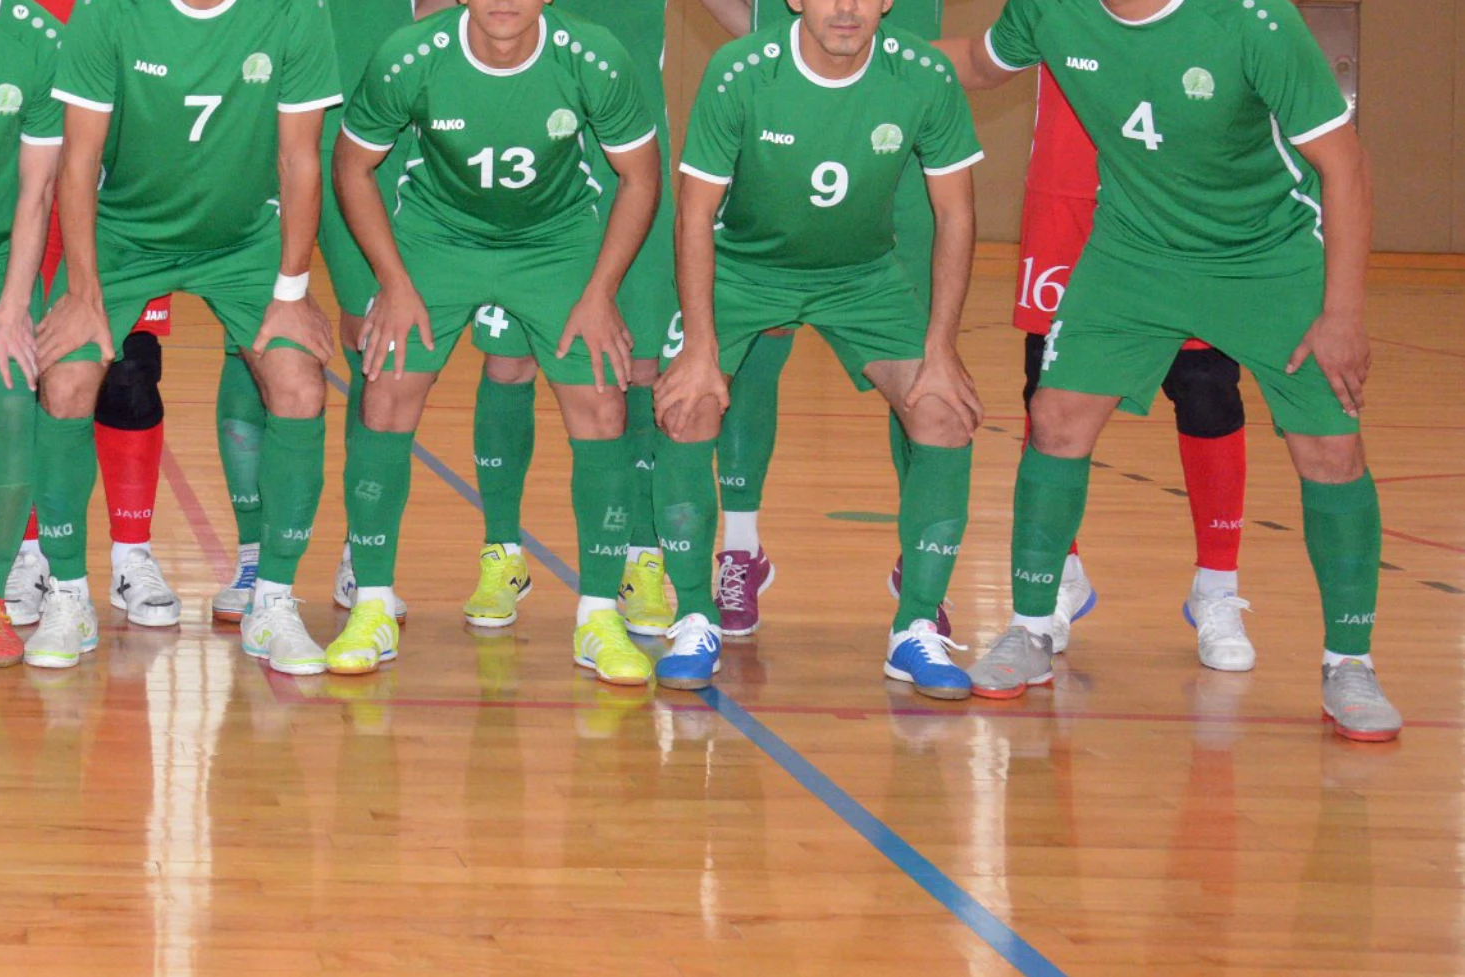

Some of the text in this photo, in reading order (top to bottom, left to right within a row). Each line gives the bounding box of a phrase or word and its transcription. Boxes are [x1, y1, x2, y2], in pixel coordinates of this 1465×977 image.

[134, 60, 167, 76] JAKO
[1066, 57, 1098, 71] JAKO
[184, 95, 222, 141] 7
[431, 119, 465, 130] JAKO
[1122, 101, 1163, 150] 4
[760, 130, 794, 144] JAKO
[468, 147, 536, 188] 13
[810, 161, 848, 207] 9
[1017, 257, 1070, 312] 16
[115, 508, 152, 520] JAKO
[38, 523, 73, 539] JAKO
[1013, 567, 1054, 584] JAKO
